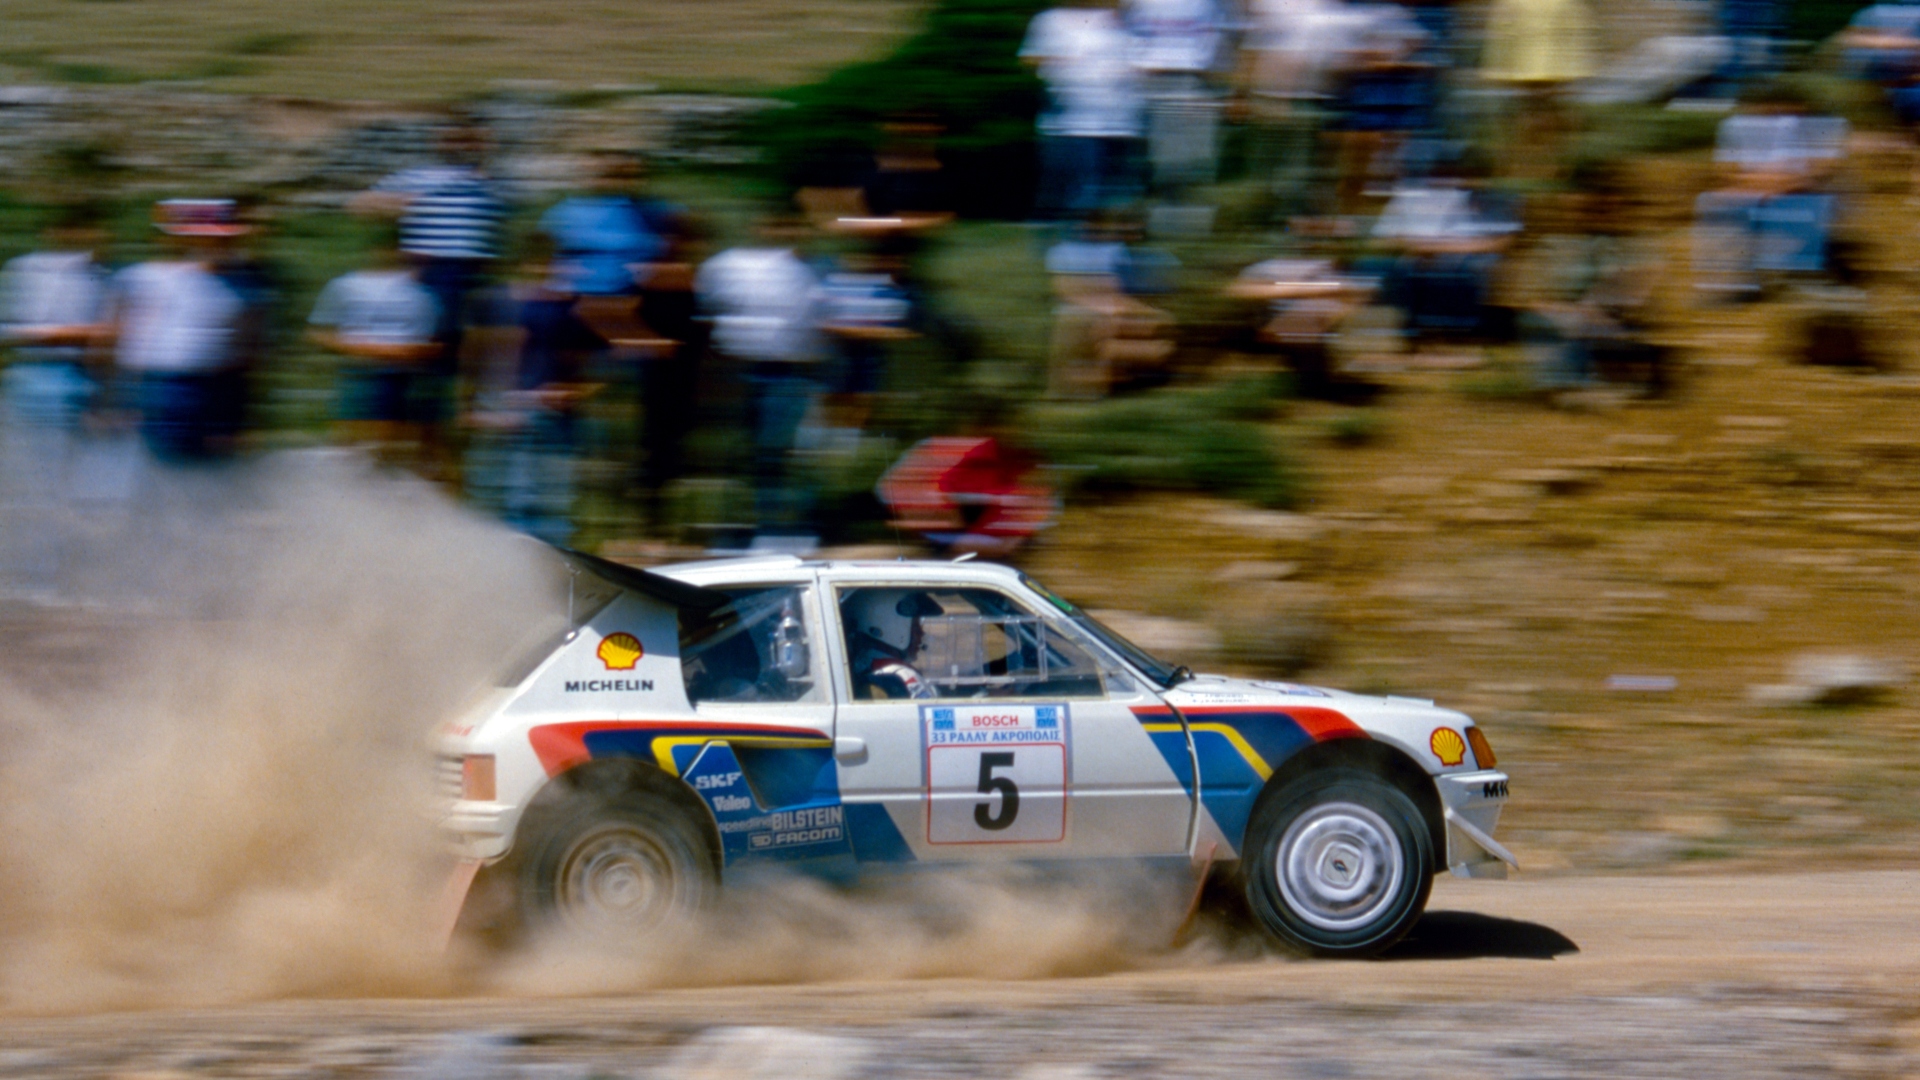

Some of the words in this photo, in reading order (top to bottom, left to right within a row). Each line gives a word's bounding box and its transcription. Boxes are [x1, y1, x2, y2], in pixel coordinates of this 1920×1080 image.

[565, 680, 654, 693] MICHELIN
[972, 715, 1019, 727] BOSCH
[932, 732, 946, 743] 33
[695, 771, 743, 790] SKF
[974, 752, 1020, 831] 5
[712, 795, 751, 812] Valeo
[772, 805, 843, 831] BILSTEIN
